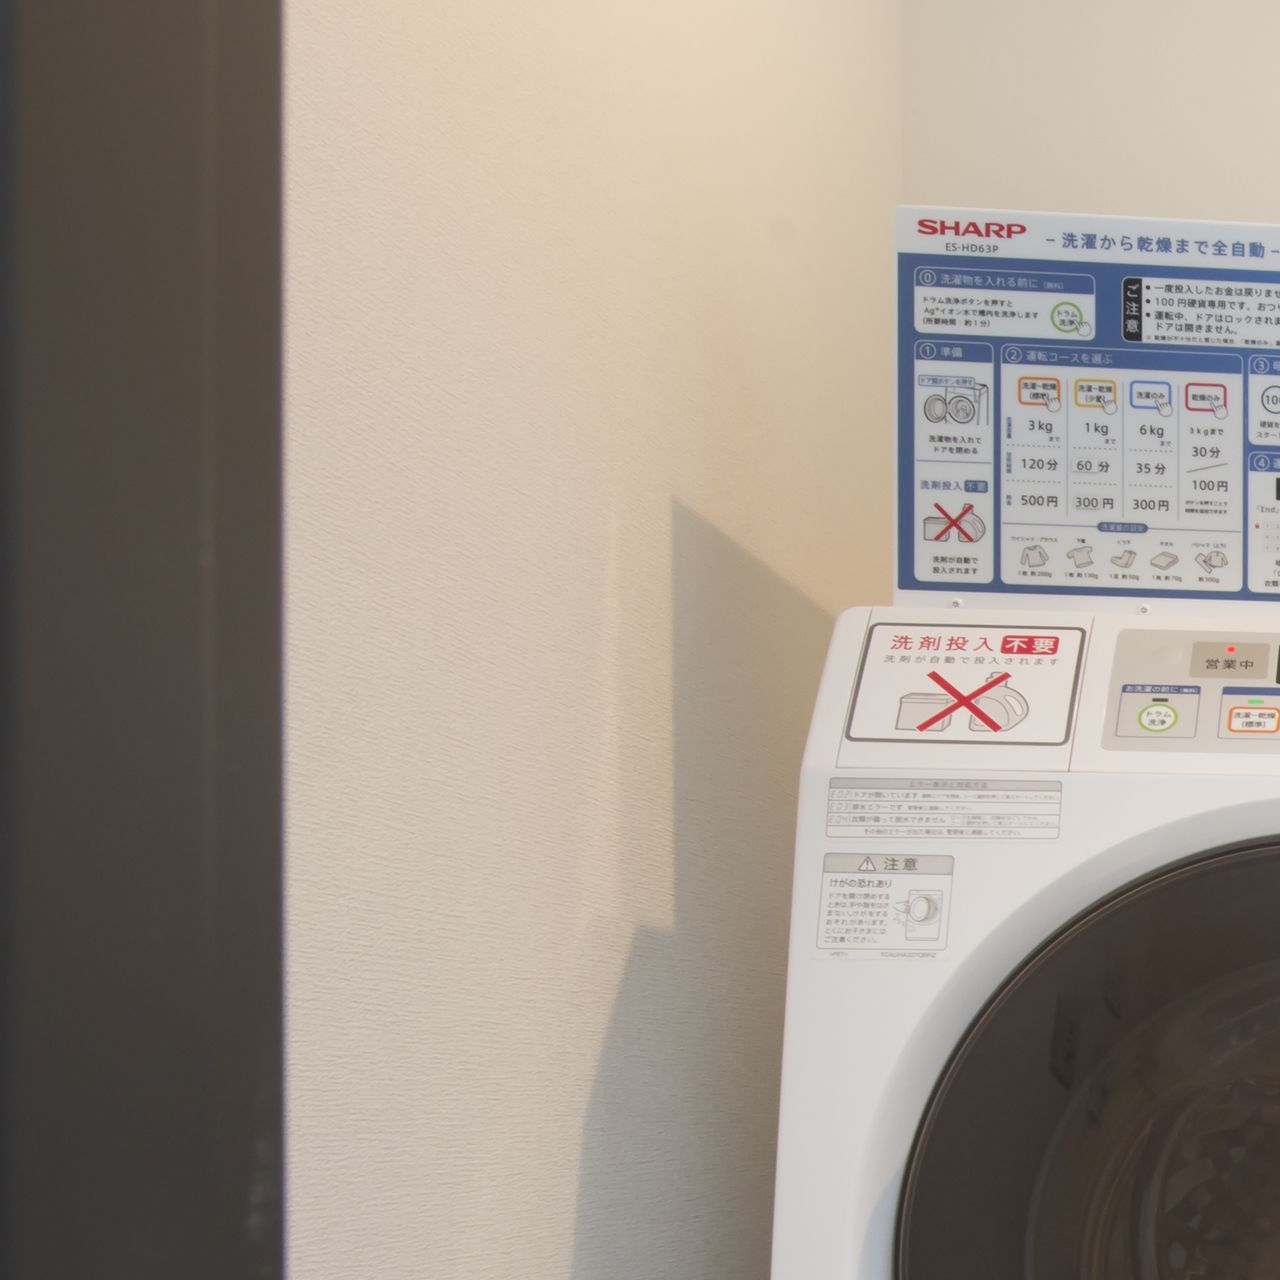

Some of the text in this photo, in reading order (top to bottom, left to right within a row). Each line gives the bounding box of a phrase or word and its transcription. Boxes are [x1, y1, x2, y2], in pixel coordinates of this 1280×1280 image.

[917, 219, 1026, 238] SHARP
[945, 243, 999, 254] ES-HD63P
[1125, 284, 1139, 333] ご注意
[1155, 323, 1238, 335] ドアは開きません。
[1027, 351, 1113, 364] 運転コースを選ぶ
[1137, 391, 1165, 400] 洗濯のみ
[1192, 394, 1220, 402] 乾燥のみ
[929, 435, 981, 444] 洗濯物を入れて
[934, 446, 978, 455] ドアを閉める
[920, 480, 962, 490] 洗剤投入
[933, 556, 978, 564] 洗剤が自動で
[933, 566, 977, 575] 投入されます
[890, 635, 1056, 653] 洗剤投入 不要
[884, 655, 1059, 666] 洗剤が自動で投入されます
[1205, 659, 1254, 669] 営業中
[884, 857, 918, 871] 注意
[829, 879, 892, 889] けがの恐れあり
